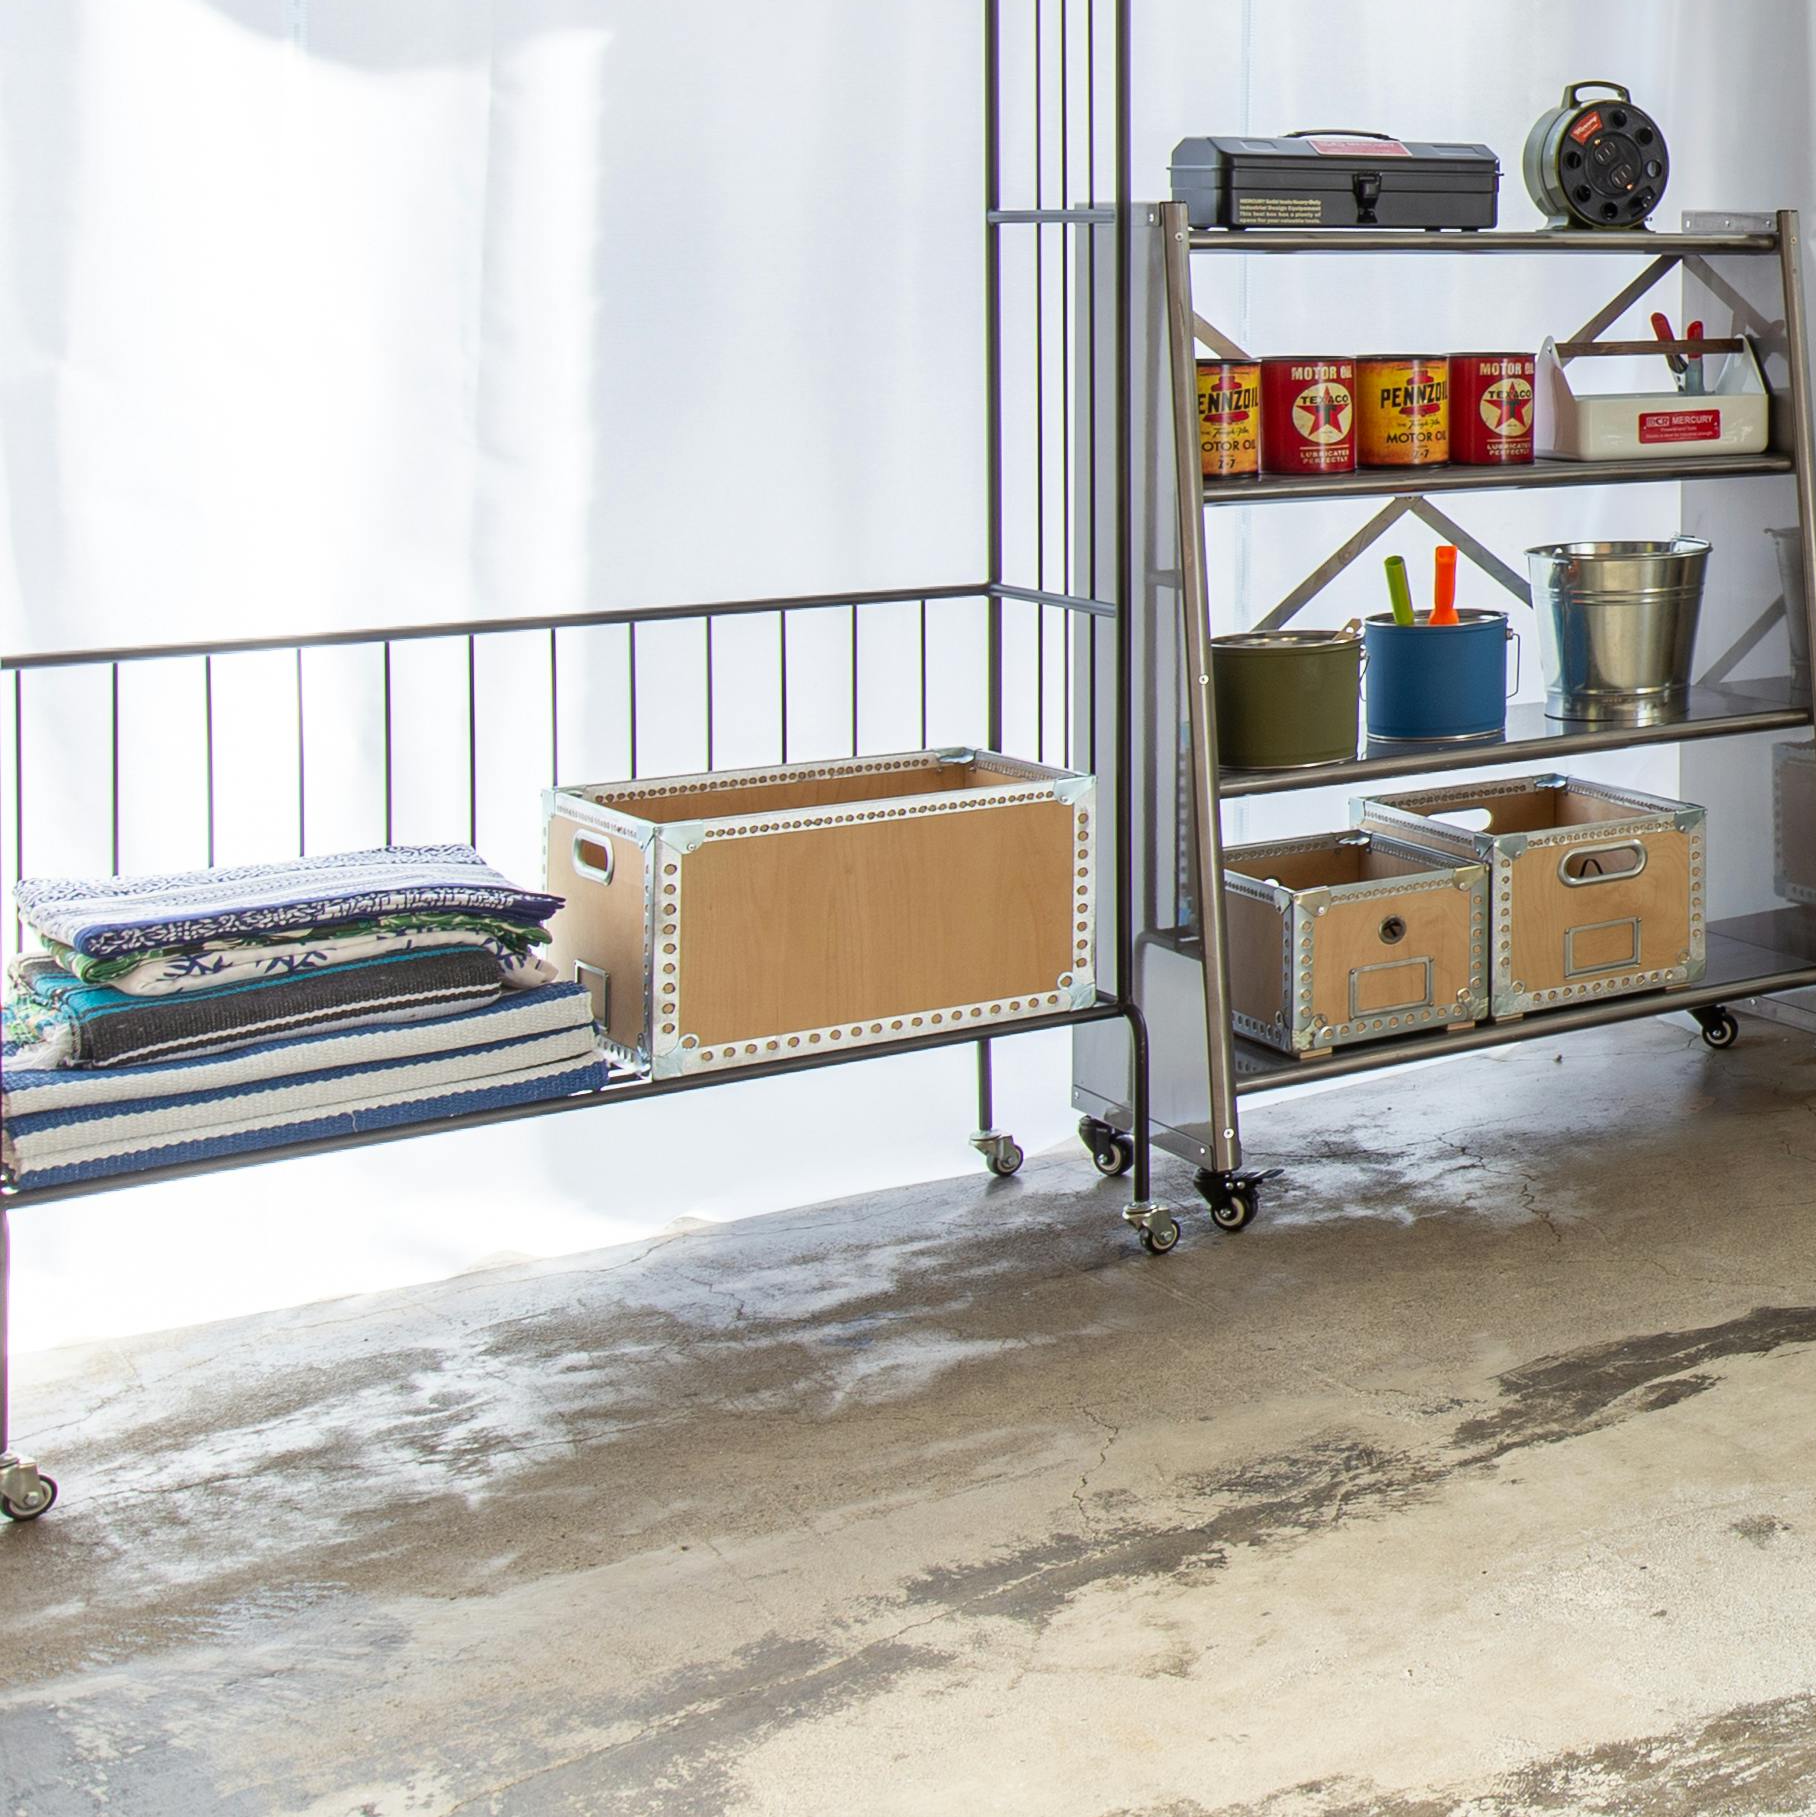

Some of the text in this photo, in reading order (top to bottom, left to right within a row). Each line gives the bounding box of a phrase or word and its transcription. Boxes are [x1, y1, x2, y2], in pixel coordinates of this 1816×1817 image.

[1291, 366, 1337, 380] MOTOR
[1480, 362, 1522, 376] MOTOR
[1299, 394, 1349, 405] TEXACO
[1380, 381, 1447, 409] PENNZOIL
[1488, 390, 1532, 399] TEXACO
[1198, 387, 1259, 415] ENNZOIL
[1672, 415, 1713, 424] MERCURY
[1386, 432, 1432, 443] MOTOR
[1202, 441, 1239, 452] OTOR
